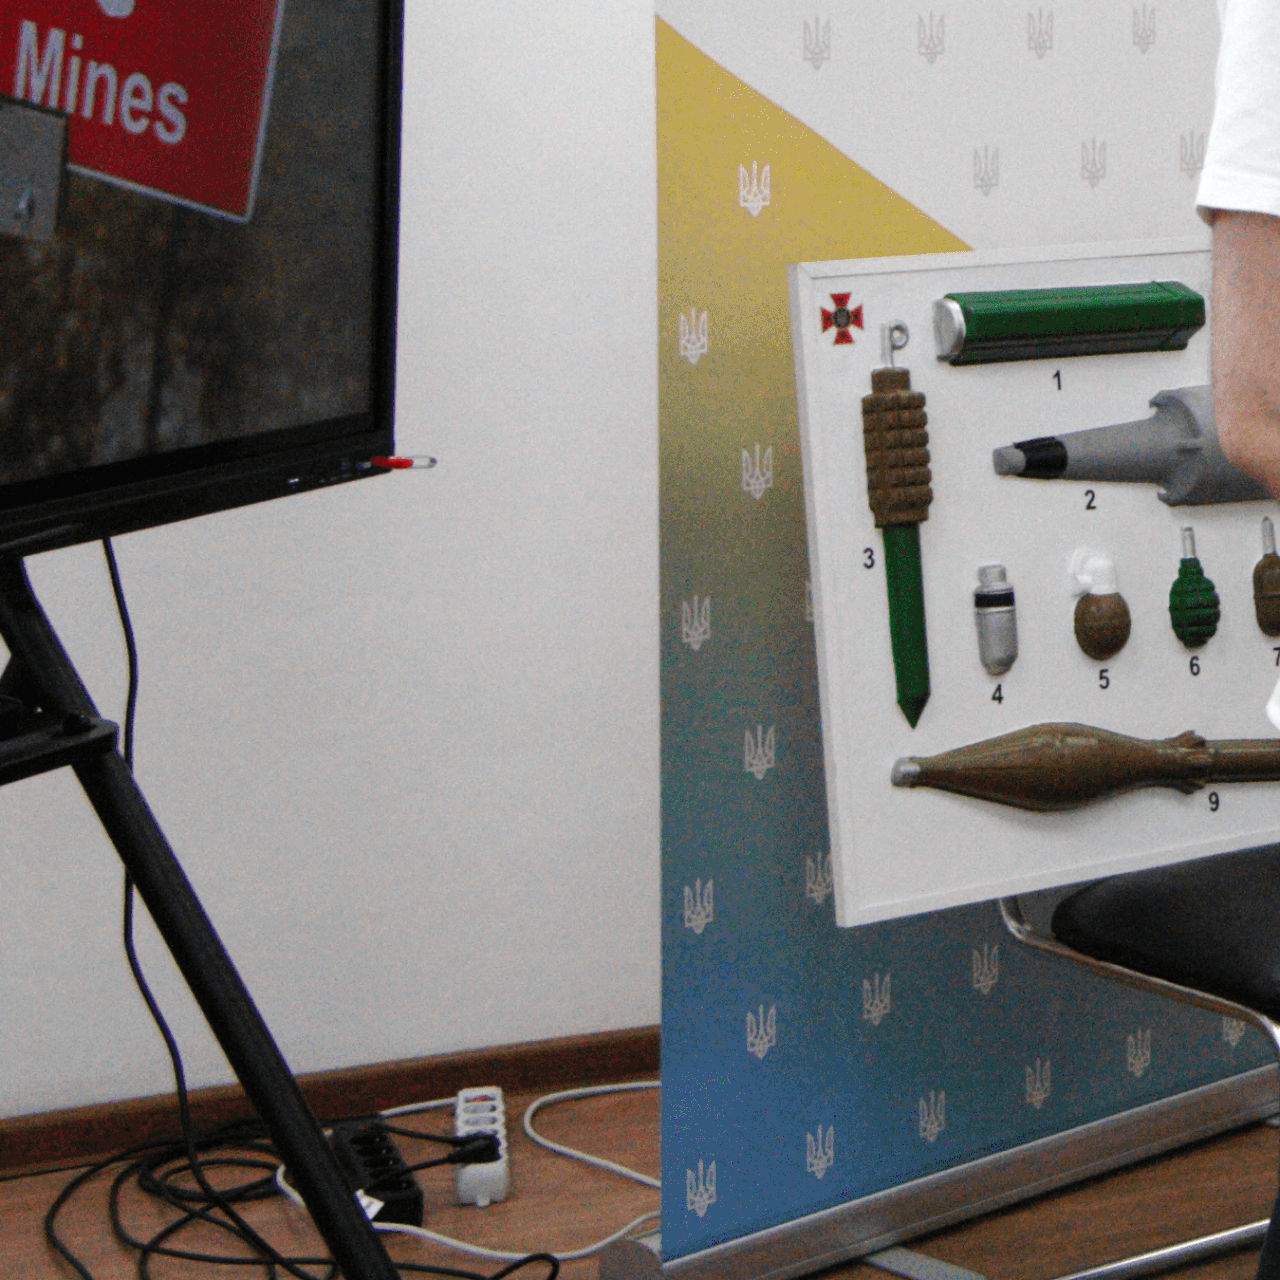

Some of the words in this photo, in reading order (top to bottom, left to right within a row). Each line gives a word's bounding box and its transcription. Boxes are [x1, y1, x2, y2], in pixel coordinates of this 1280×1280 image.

[14, 19, 189, 145] Mines
[1053, 371, 1062, 390] 1
[1085, 491, 1097, 510] 2
[863, 549, 875, 568] 3
[1190, 656, 1200, 675] 6
[1099, 669, 1110, 688] 5
[991, 684, 1004, 704] 4
[1209, 793, 1220, 811] 9
